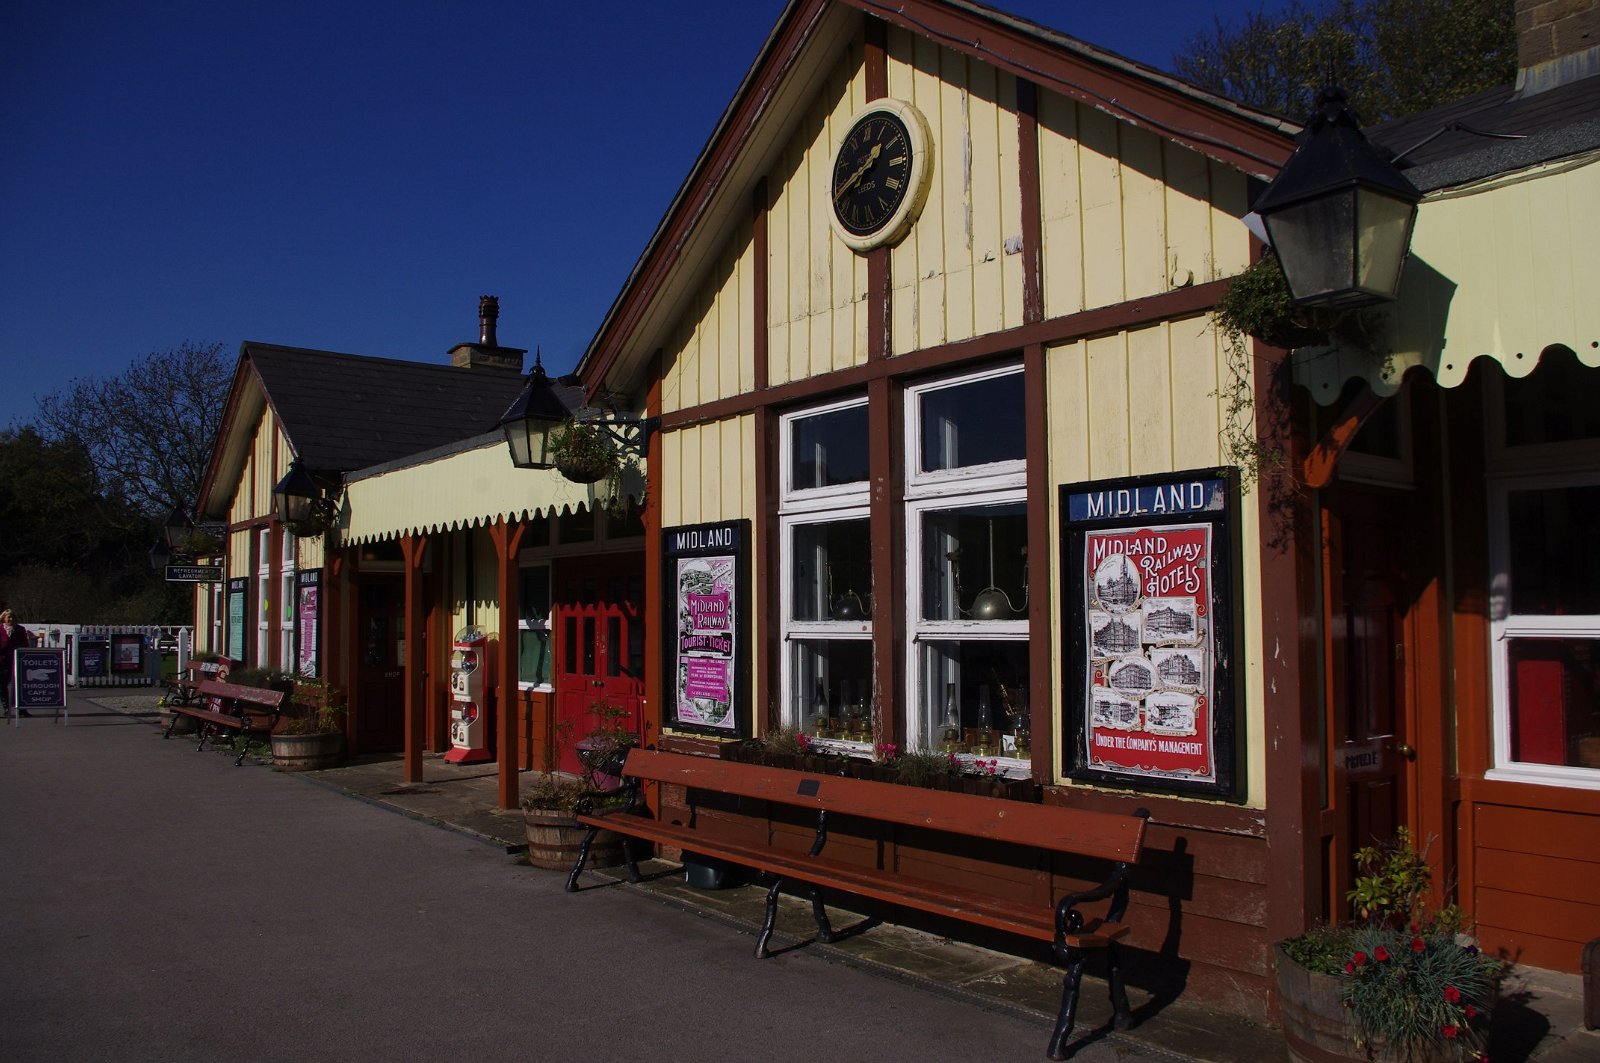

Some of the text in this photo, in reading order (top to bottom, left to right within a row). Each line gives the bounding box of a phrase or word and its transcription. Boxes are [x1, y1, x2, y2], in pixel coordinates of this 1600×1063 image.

[858, 180, 876, 194] LEEDS
[1088, 482, 1204, 518] MIDLAND
[676, 528, 732, 550] MIDLAND
[1093, 537, 1168, 570] MIDLAND
[1140, 544, 1202, 578] RAILWAY
[1146, 564, 1200, 597] HOTELS
[691, 599, 724, 615] MIDLAND
[698, 614, 726, 629] RAILWAY
[681, 635, 706, 650] TOURIST
[709, 635, 731, 652] TICKET
[1096, 733, 1202, 755] UNDER THE COMPANY'S MANAGEMENT
